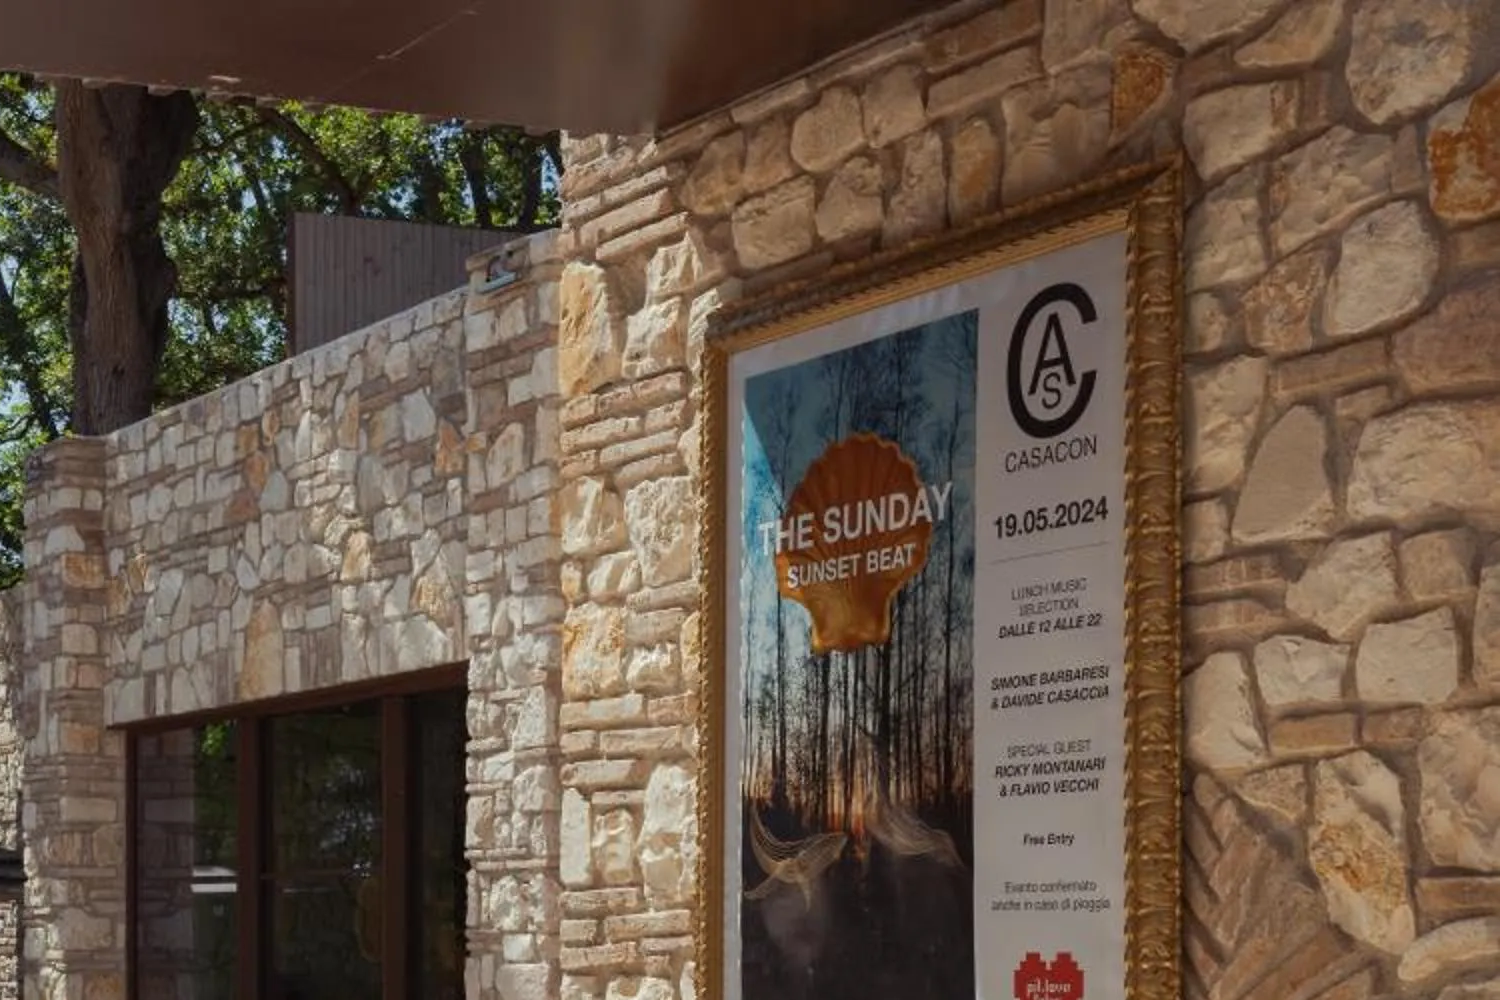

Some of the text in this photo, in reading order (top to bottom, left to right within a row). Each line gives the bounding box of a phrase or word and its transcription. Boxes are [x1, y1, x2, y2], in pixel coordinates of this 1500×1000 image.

[1005, 435, 1097, 473] CASACON
[758, 480, 952, 556] THE SUNDAY
[993, 496, 1108, 539] 19.05.2024
[787, 543, 916, 589] SUNSET BEAT
[1011, 578, 1087, 601] LUNCH MUSIC
[1019, 597, 1079, 616] SELECTION
[998, 621, 1035, 639] DALLE
[1053, 615, 1084, 630] ALLE
[1087, 613, 1102, 626] 22
[991, 665, 1109, 691] SIMONE BARBARESI
[1001, 691, 1044, 709] DAVIDE
[1007, 739, 1091, 758] SPECIAL GUEST
[996, 756, 1106, 778] RICKY MONTANARI
[1010, 781, 1051, 796] FLAVIO
[1053, 778, 1100, 793] VECCHI
[1023, 833, 1075, 846] Free Entry
